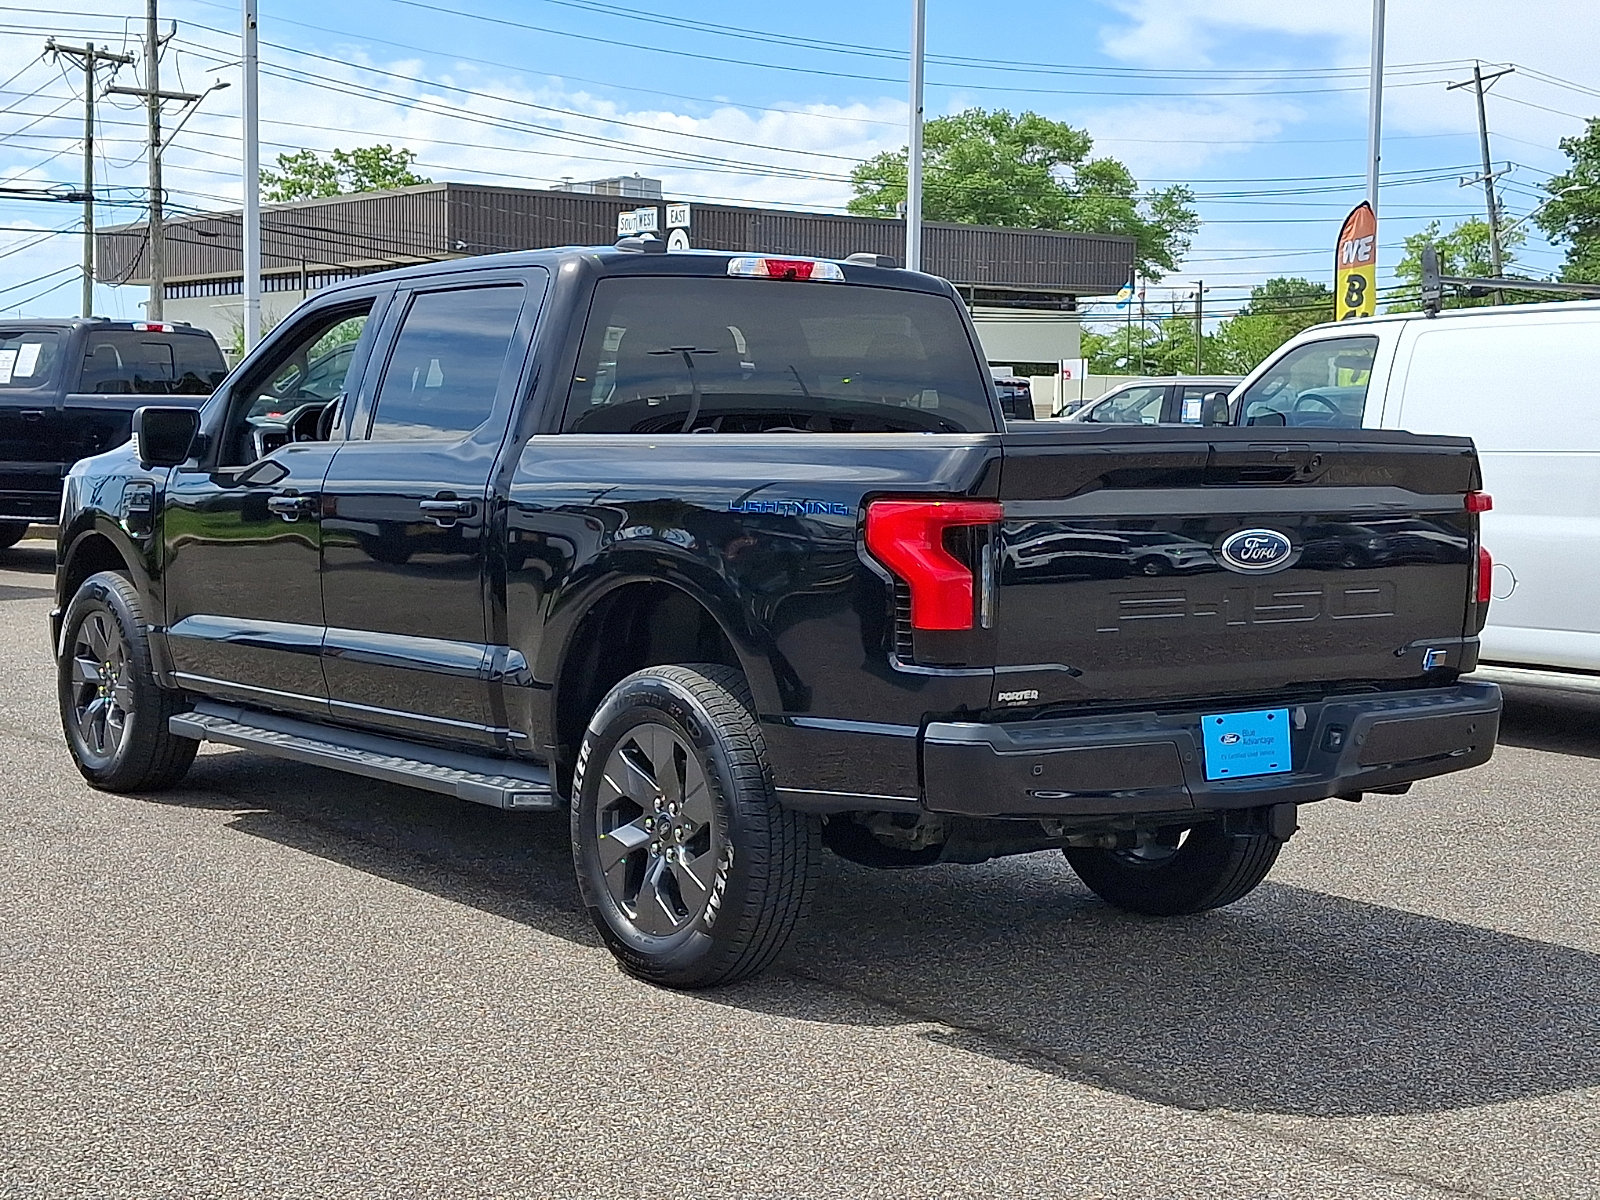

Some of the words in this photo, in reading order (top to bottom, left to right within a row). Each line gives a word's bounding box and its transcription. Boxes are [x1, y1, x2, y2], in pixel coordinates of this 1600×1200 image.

[620, 217, 637, 231] SOUT
[638, 213, 655, 227] WEST
[670, 210, 686, 224] EAST
[1342, 235, 1374, 265] WE
[728, 499, 849, 517] LIGHTNING
[1240, 537, 1278, 560] Ford
[997, 689, 1039, 702] PORTER
